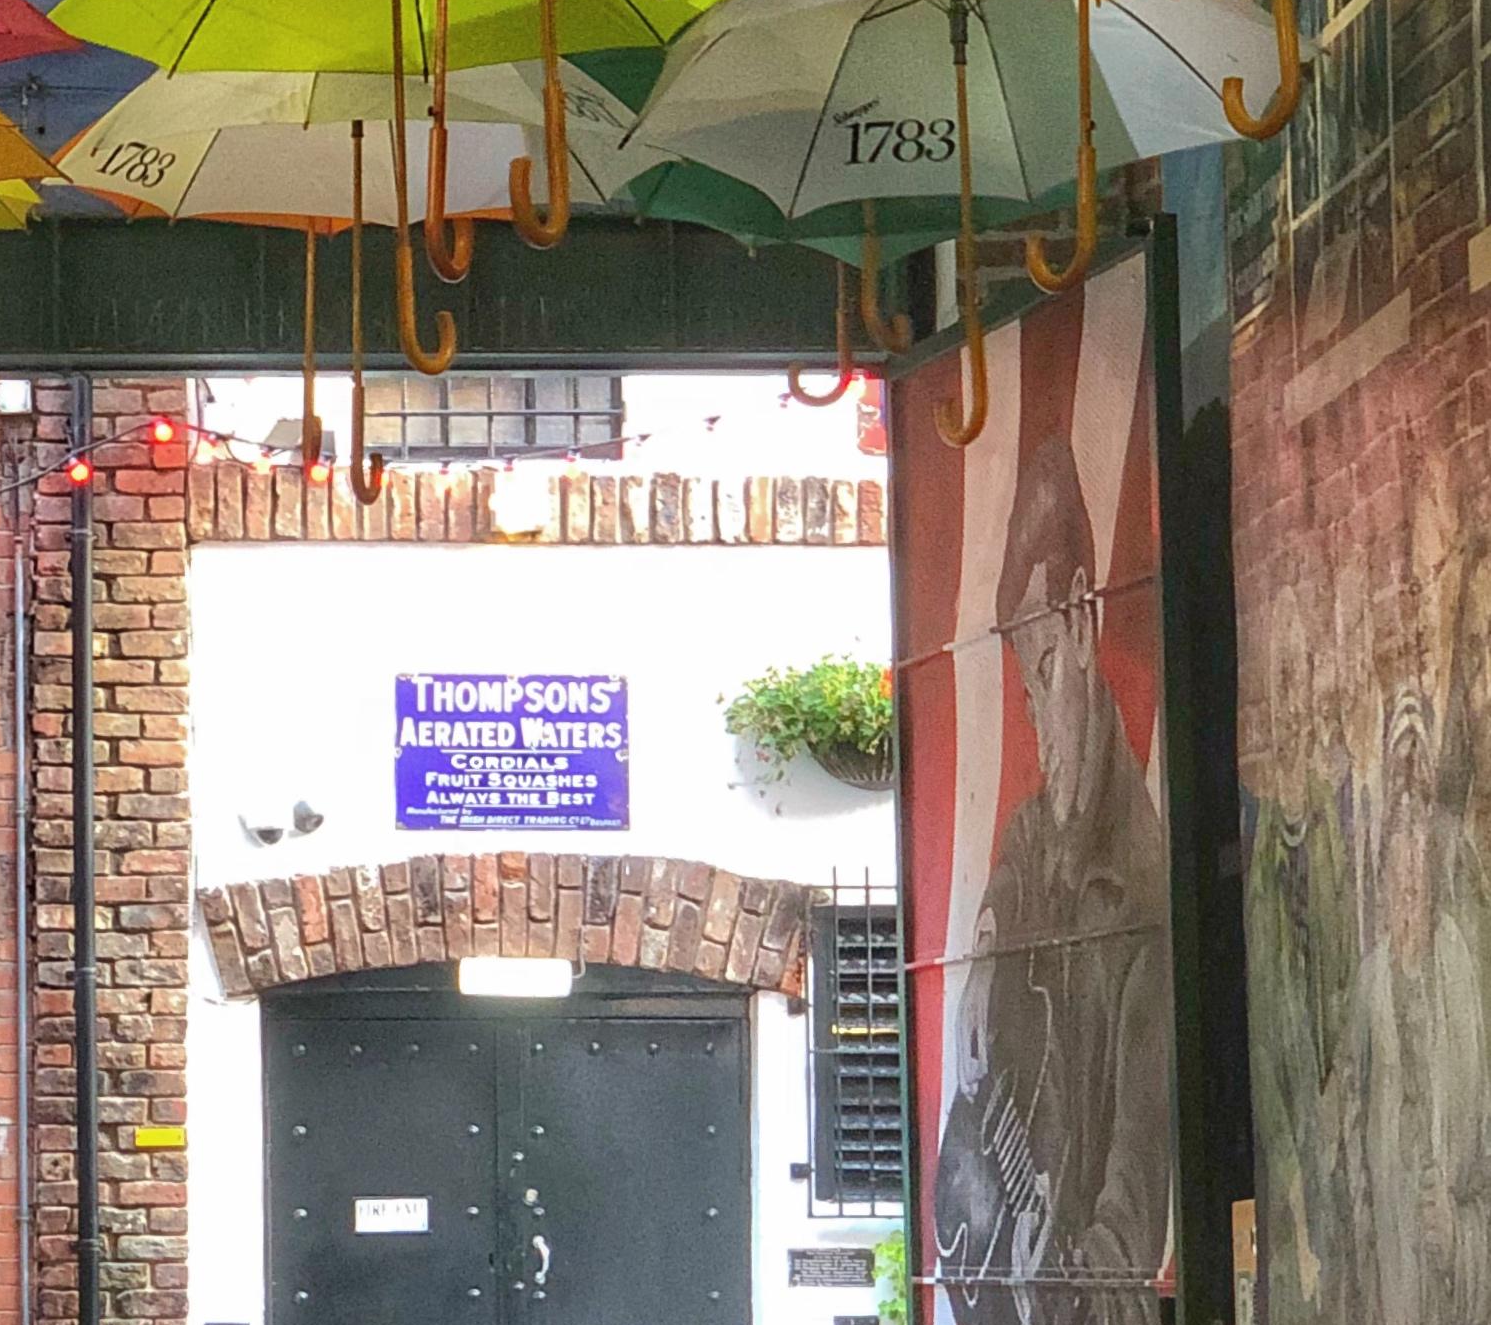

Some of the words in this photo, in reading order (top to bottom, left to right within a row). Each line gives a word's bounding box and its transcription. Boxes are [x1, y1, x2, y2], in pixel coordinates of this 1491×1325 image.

[844, 118, 956, 165] 1783
[95, 141, 176, 188] 1783
[400, 716, 516, 747] AERATED
[520, 717, 622, 748] WATERS
[450, 754, 569, 770] CORDIALS
[425, 771, 483, 787] FRUIT
[487, 772, 598, 788] SQUASHES
[426, 791, 501, 805] ALWAYS
[506, 792, 541, 805] THE
[546, 791, 596, 805] BEST
[524, 816, 566, 824] TRADING
